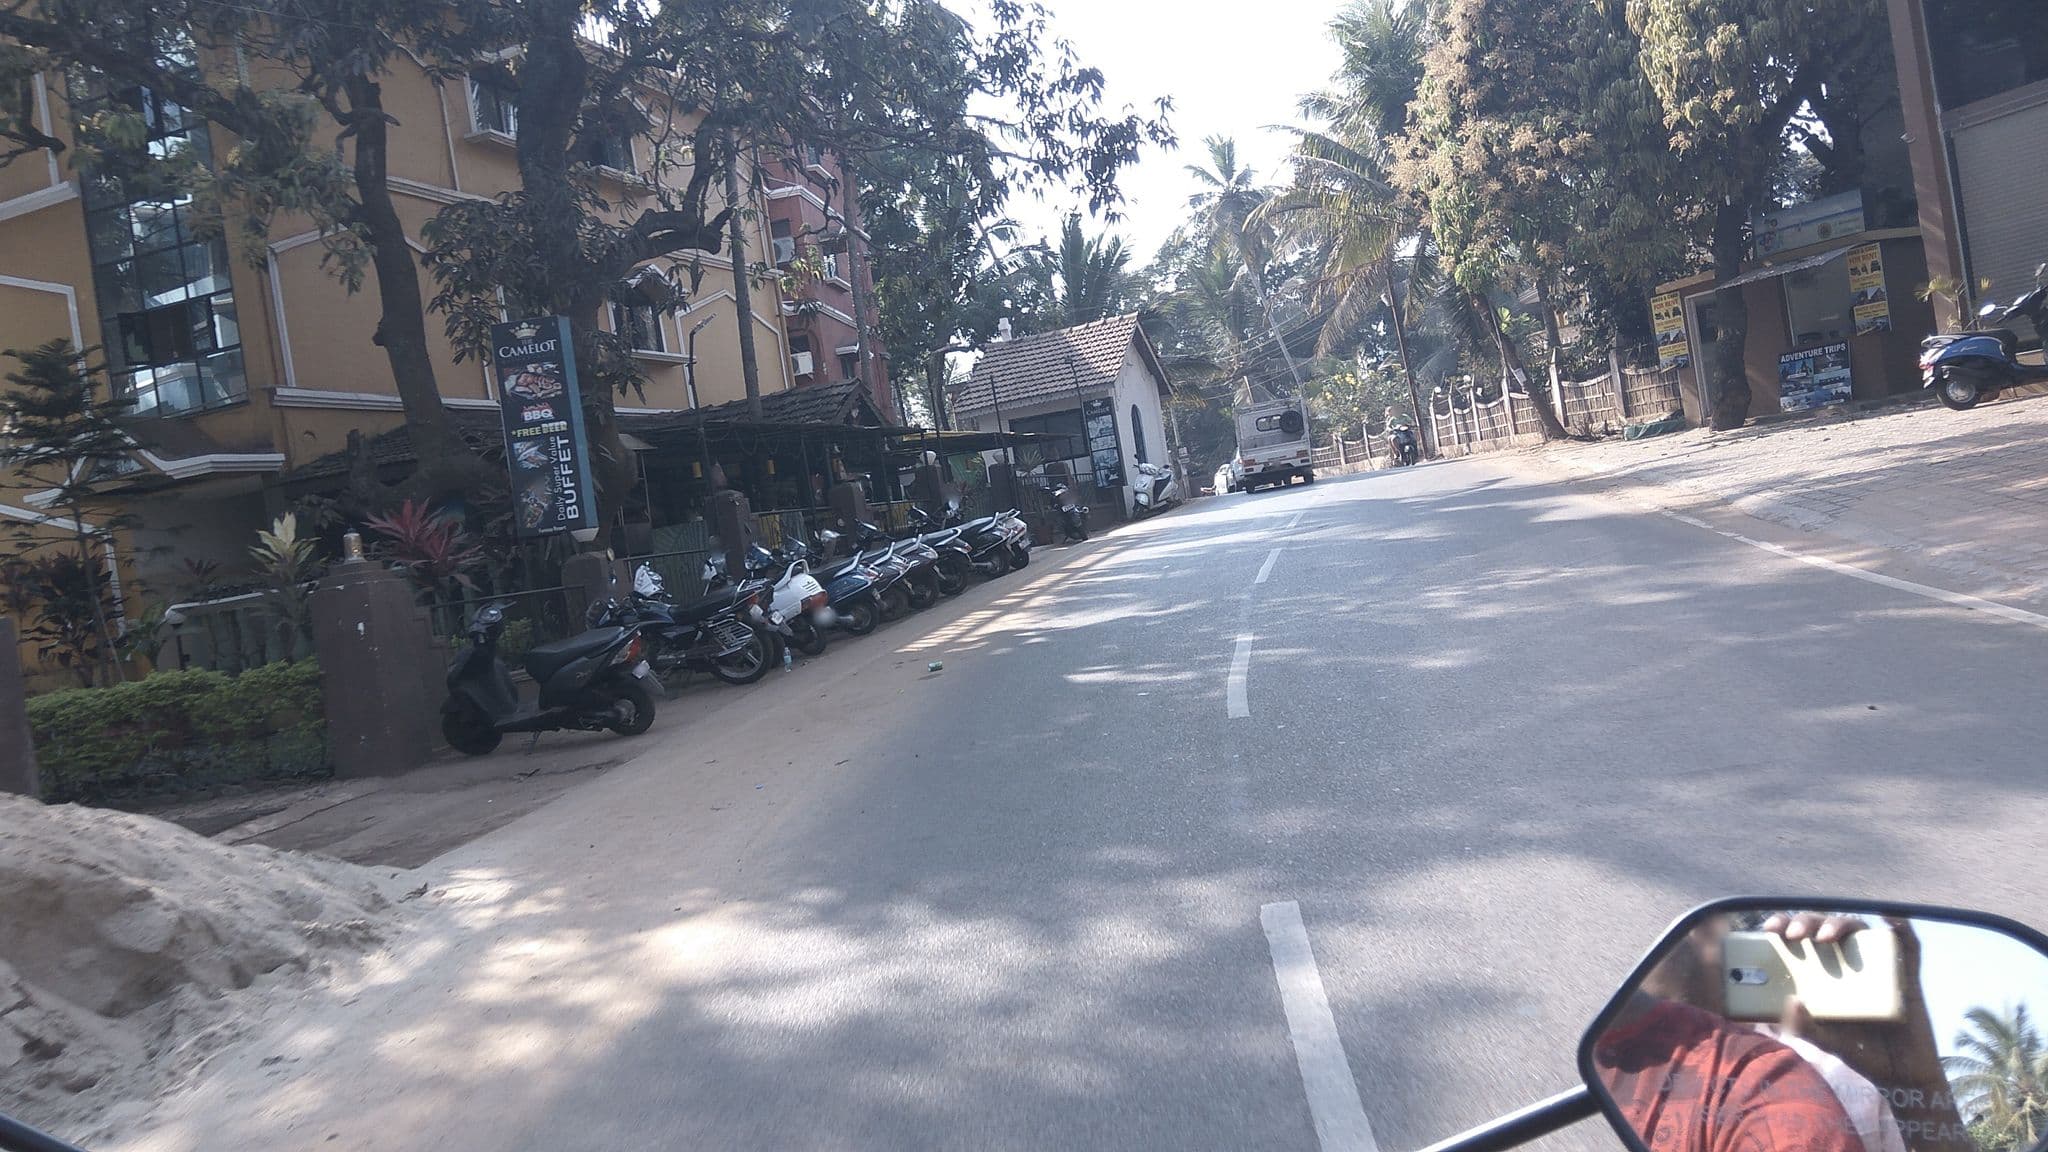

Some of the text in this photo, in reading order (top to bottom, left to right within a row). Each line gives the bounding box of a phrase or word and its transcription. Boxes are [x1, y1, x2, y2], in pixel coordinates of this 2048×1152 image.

[499, 339, 557, 358] CAMELOT
[1780, 342, 1846, 363] ADVENTURE TRIPS
[523, 409, 554, 421] BBQ
[541, 420, 568, 434] BEER
[548, 436, 566, 521] Daily Super Value
[556, 435, 579, 519] BUFFET
